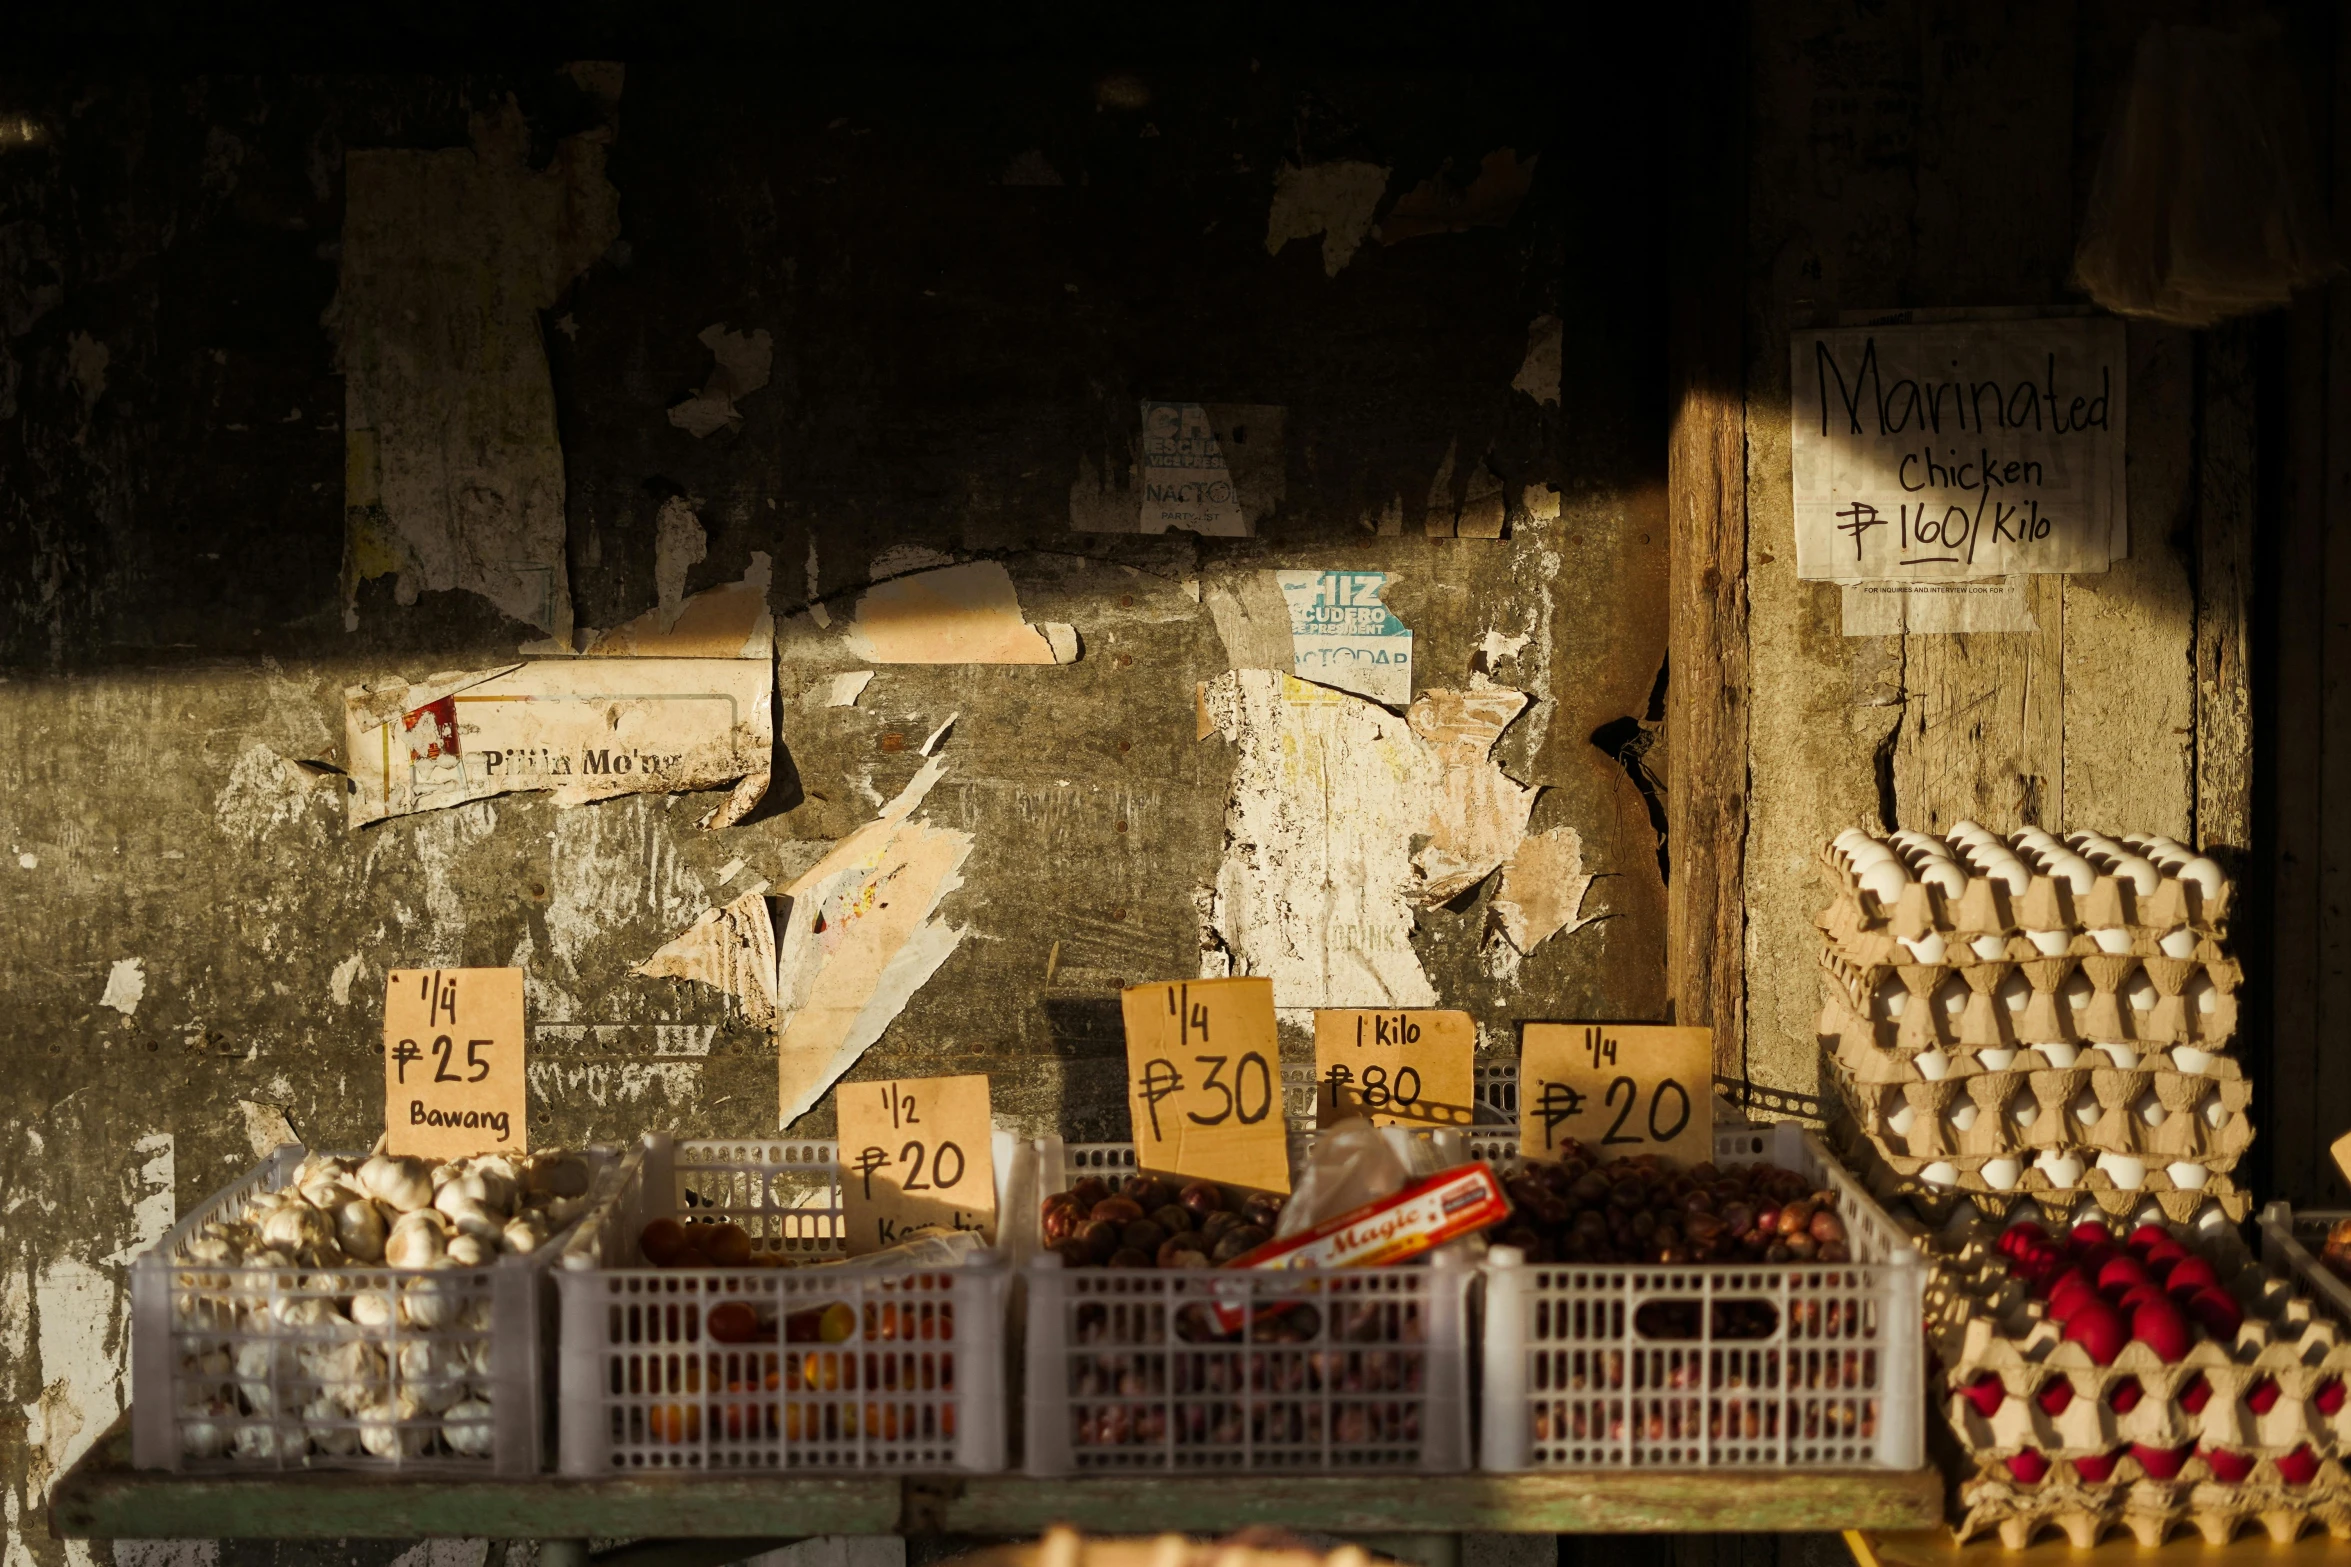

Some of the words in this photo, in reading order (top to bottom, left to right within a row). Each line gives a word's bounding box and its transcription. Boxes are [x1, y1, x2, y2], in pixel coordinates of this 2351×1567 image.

[1815, 337, 2109, 437] Marinated
[1150, 455, 1180, 467] VICE
[1184, 455, 1226, 468] PRESI
[1898, 446, 2043, 492] Chicken
[1161, 512, 1195, 521] PARTY
[1310, 623, 1385, 635] PRESIDENT
[421, 969, 456, 1028] 1/4
[1168, 983, 1209, 1046] 1/4
[1356, 1015, 1363, 1048] 1
[1585, 1026, 1617, 1069] 1/4
[410, 1099, 511, 1143] Bawang
[881, 1082, 920, 1129] 1/2
[1326, 1207, 1420, 1261] Magic
